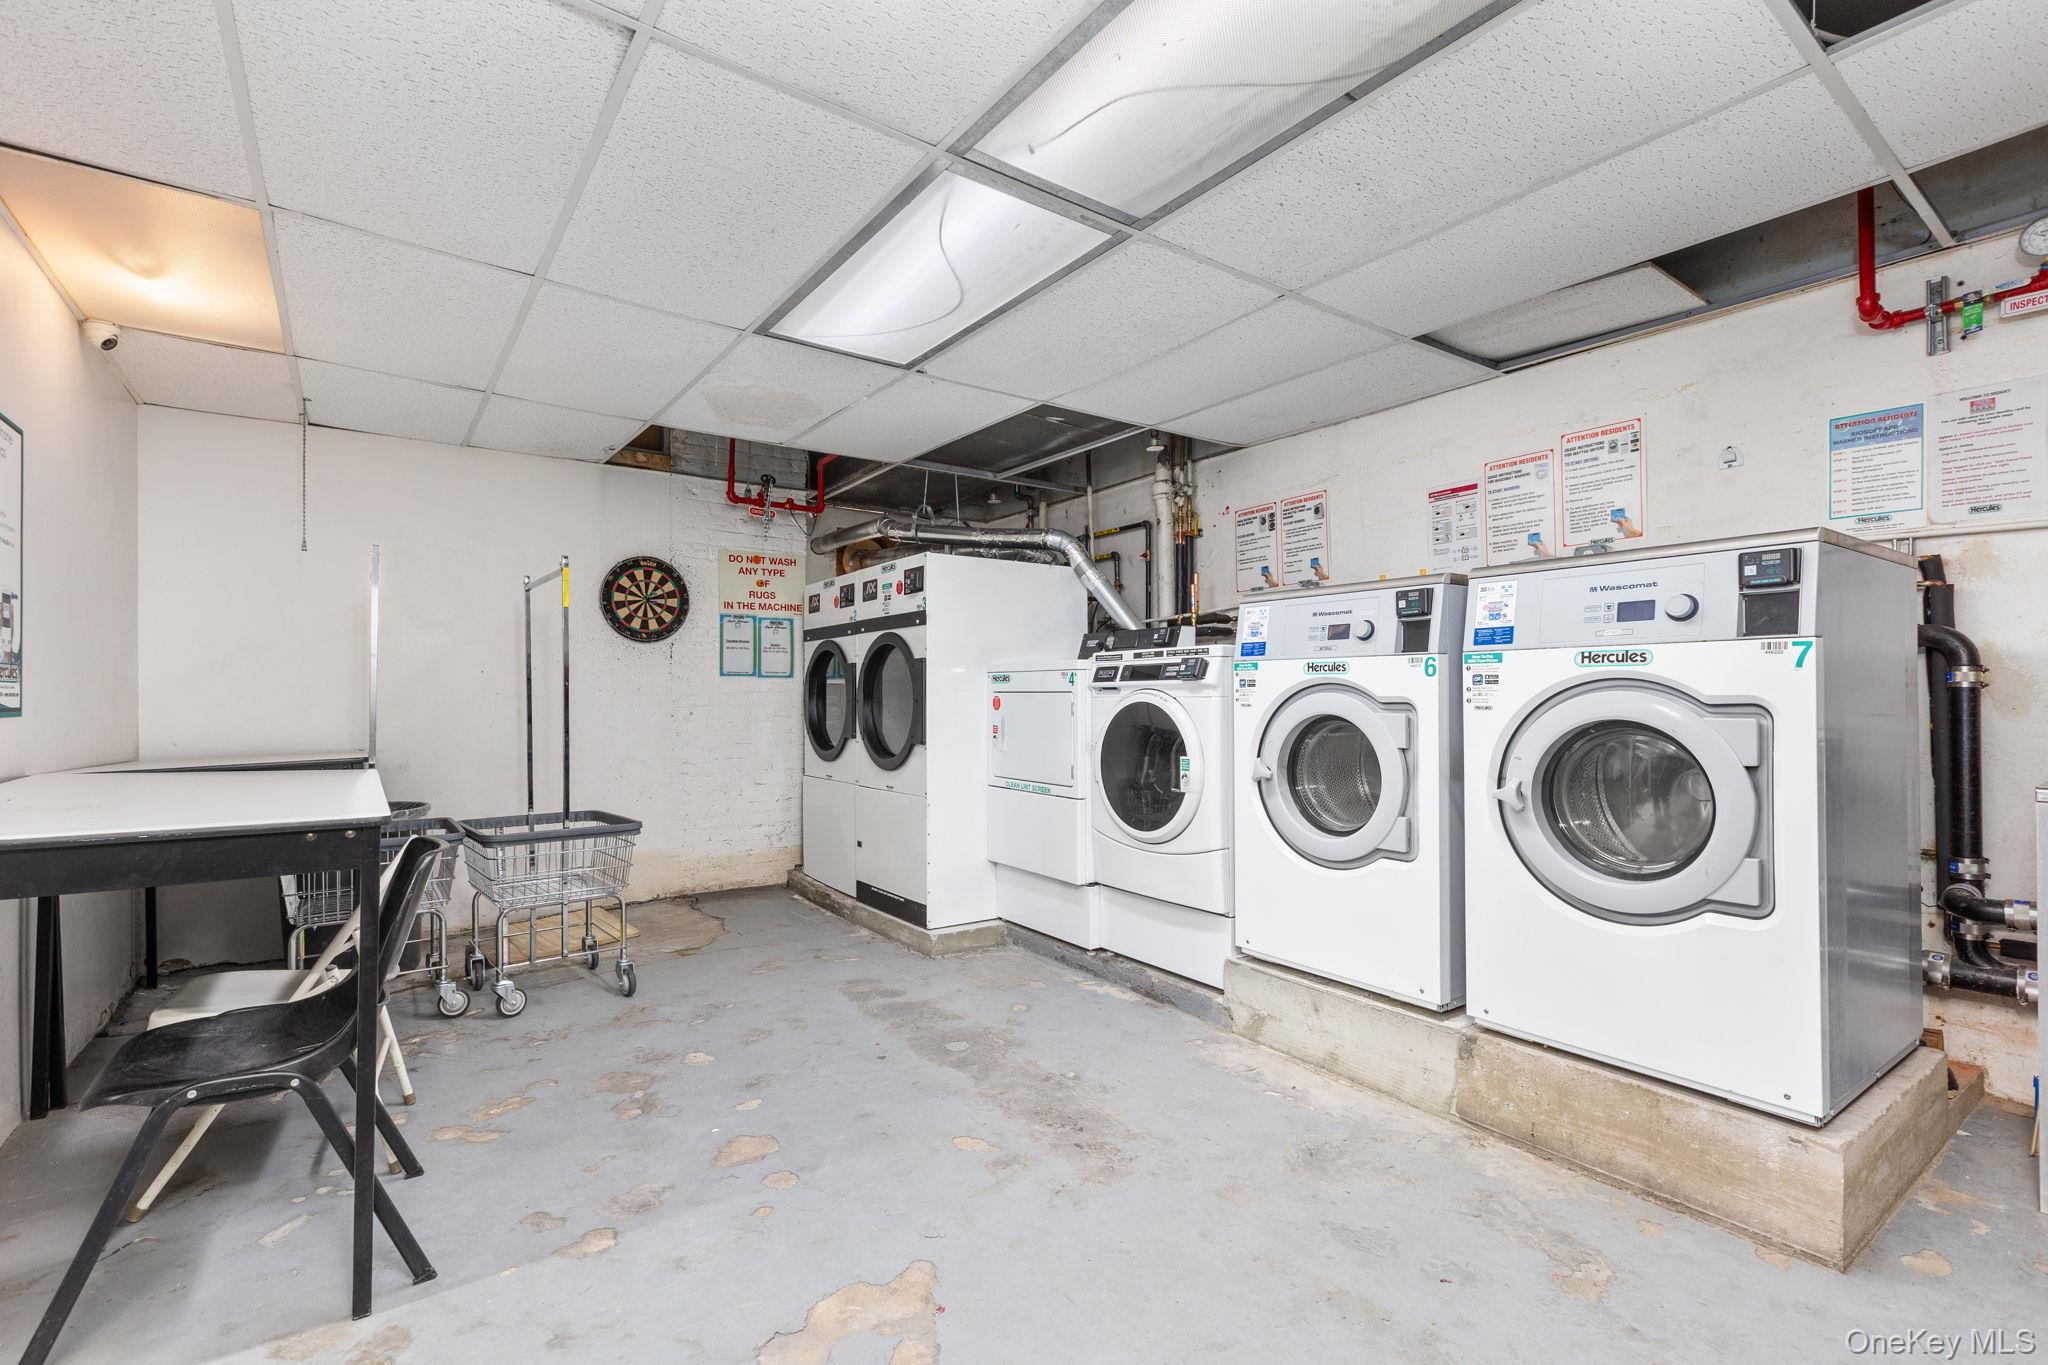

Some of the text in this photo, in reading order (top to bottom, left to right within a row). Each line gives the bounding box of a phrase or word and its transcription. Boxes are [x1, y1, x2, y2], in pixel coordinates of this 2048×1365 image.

[1834, 410, 1919, 429] ATTENTION RESIDENTS
[1567, 424, 1635, 443] ATTENTION RESIDENTS
[1833, 428, 1919, 445] WASHER INSTRUCTIONS
[1851, 427, 1881, 436] KIOSOFT
[1490, 454, 1548, 471] ATTENTION RESIDENTS
[1970, 504, 2000, 513] Hercules
[1857, 515, 1890, 523] Hercules
[729, 555, 796, 566] DO NT WASH
[738, 567, 785, 577] ANY TYPE
[1600, 582, 1658, 591] Wascomat
[749, 591, 776, 599] RUGS
[737, 602, 755, 610] THE
[758, 603, 802, 612] MACHINE
[922, 597, 926, 609] 3
[1581, 650, 1647, 664] Hercules
[1791, 641, 1813, 668] 7
[1308, 662, 1346, 672] Hercules
[1424, 657, 1436, 677] 6
[1069, 672, 1074, 686] 4
[1032, 785, 1051, 793] SCREEN
